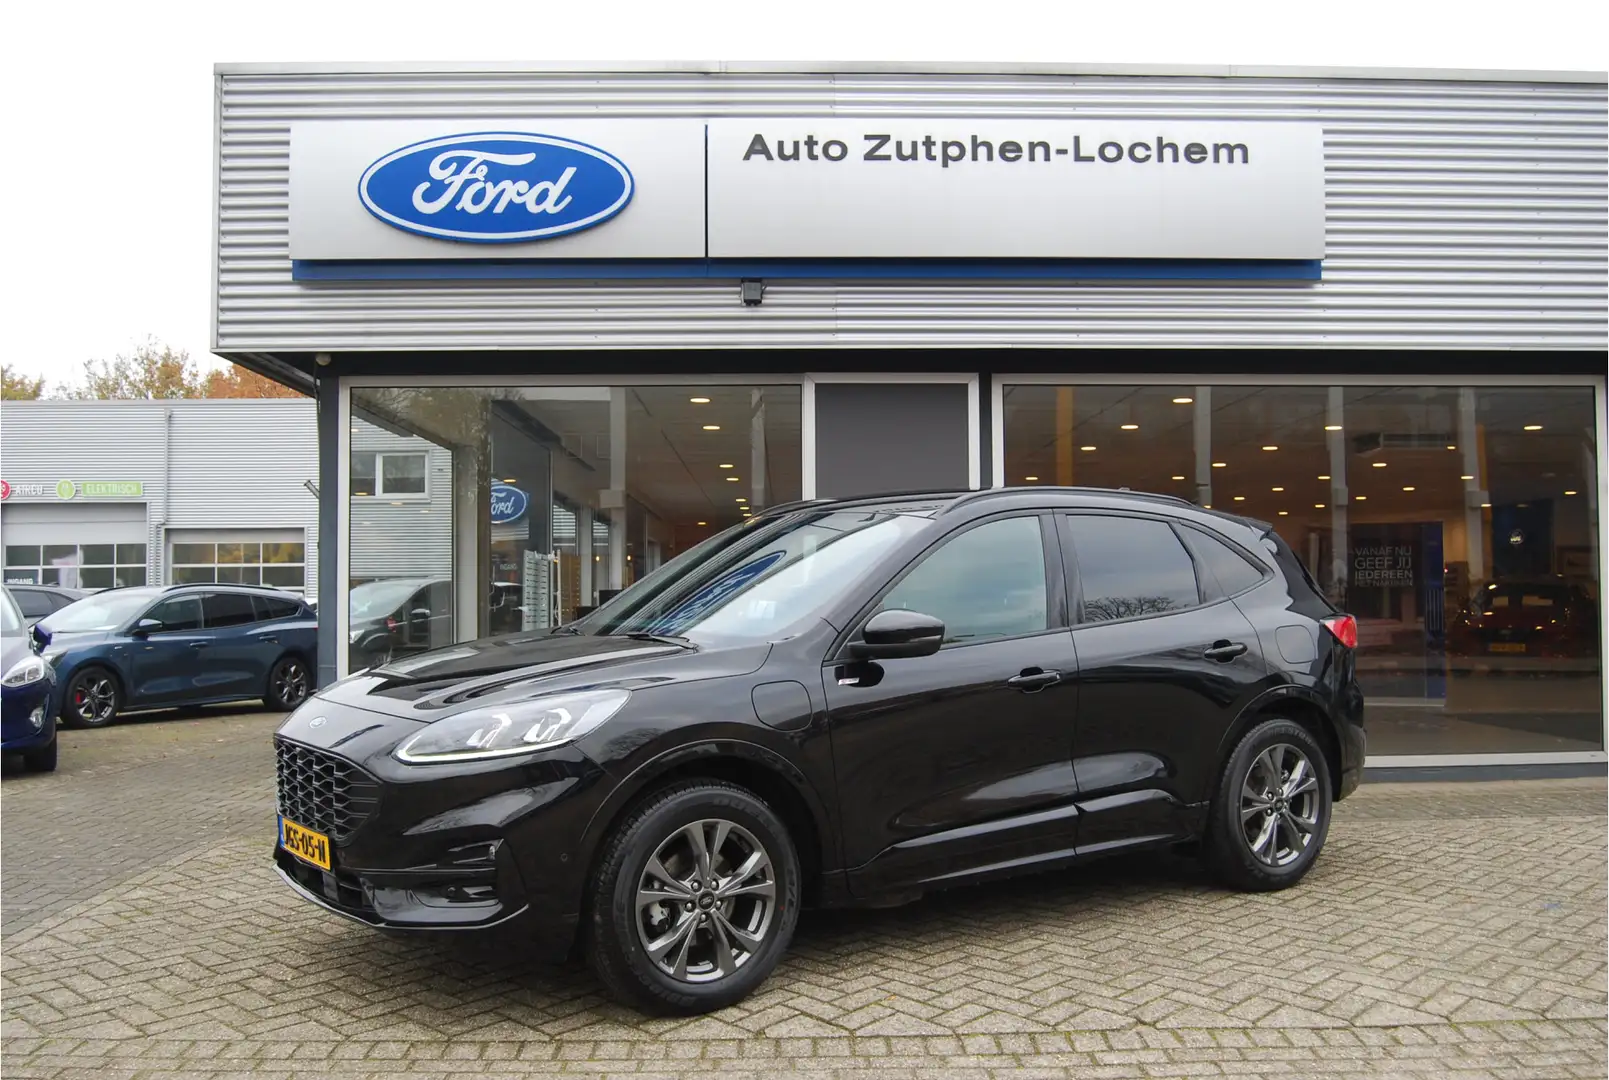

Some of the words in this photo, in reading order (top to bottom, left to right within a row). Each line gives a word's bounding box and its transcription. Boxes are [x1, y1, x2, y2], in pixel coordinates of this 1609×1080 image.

[743, 134, 847, 161] Auto
[864, 135, 1249, 168] Zutphen-Lochem
[412, 150, 577, 214] Ford
[1354, 546, 1393, 556] VANAF
[1395, 546, 1412, 556] NU
[1354, 557, 1393, 570] GEEF
[1397, 556, 1412, 570] JIJ
[1354, 570, 1413, 580] IEDEREEN
